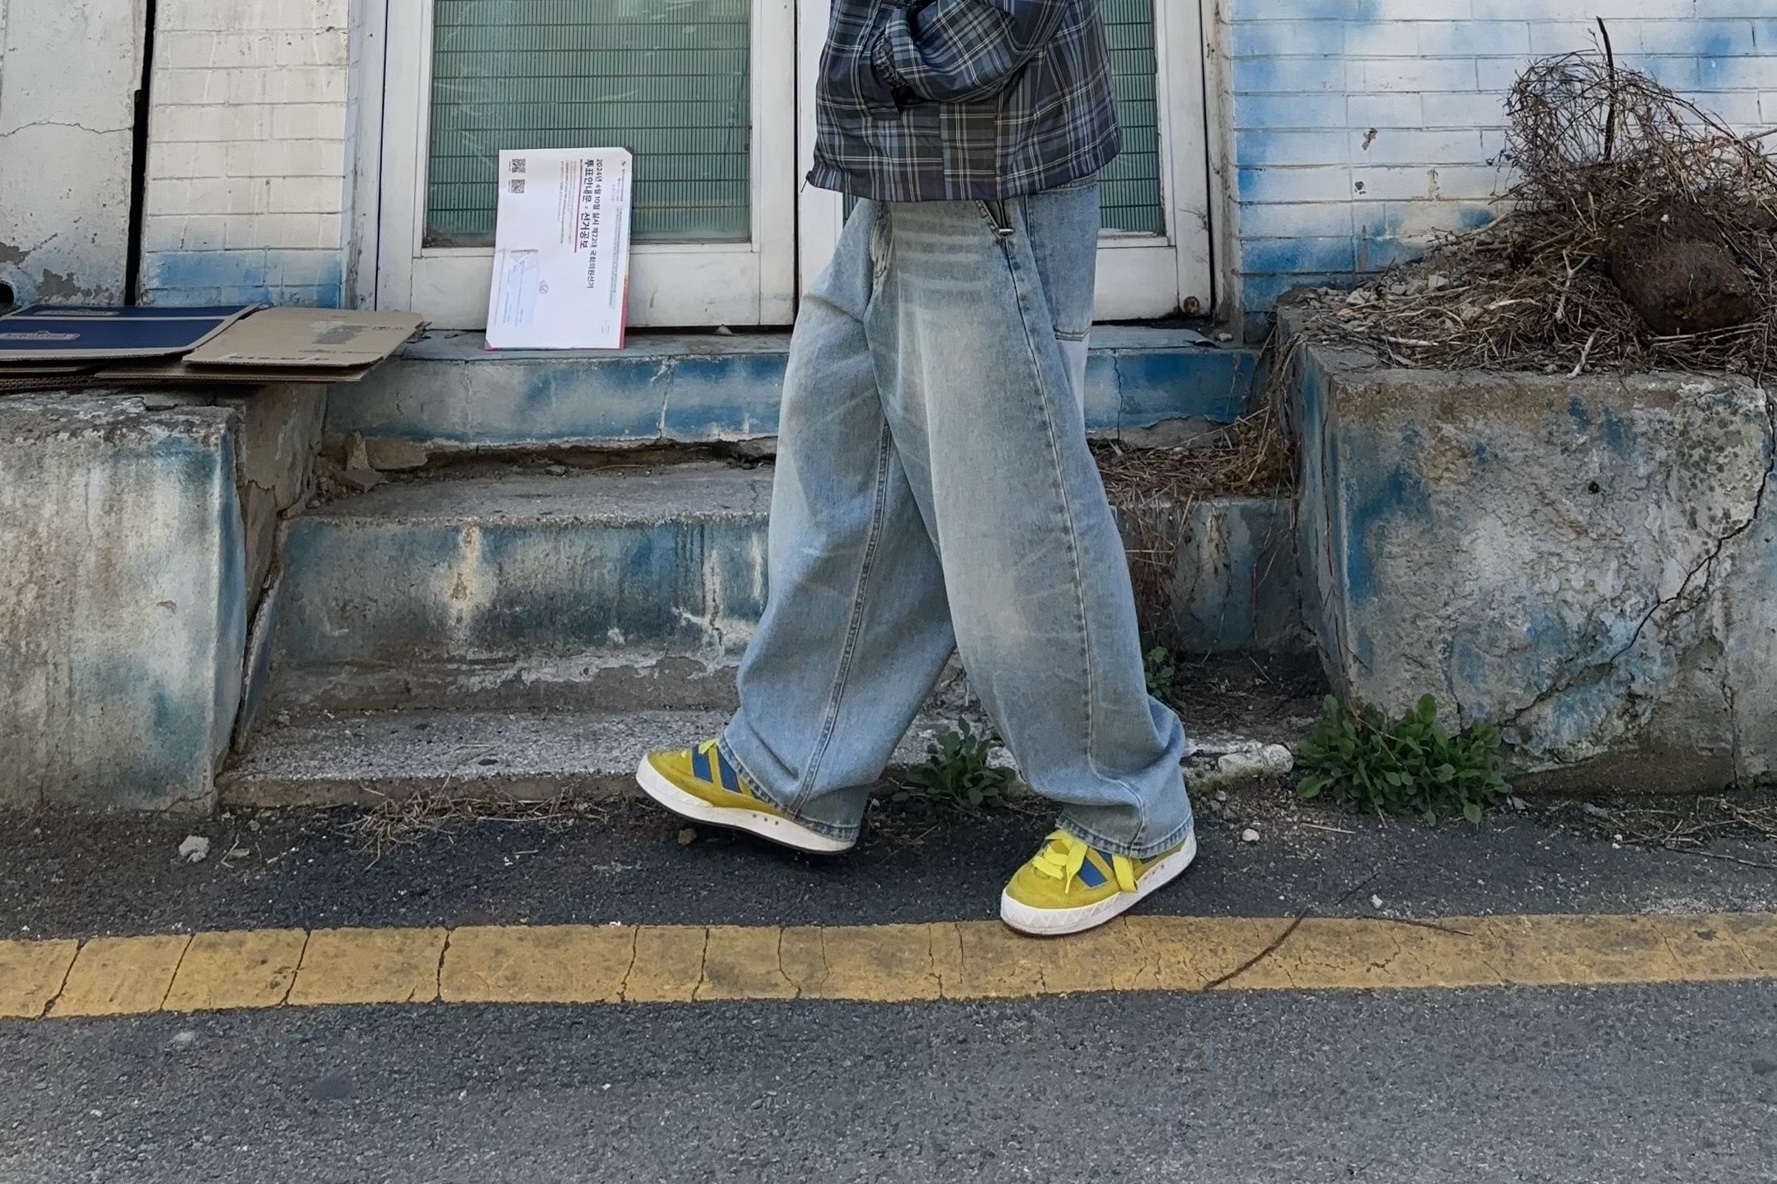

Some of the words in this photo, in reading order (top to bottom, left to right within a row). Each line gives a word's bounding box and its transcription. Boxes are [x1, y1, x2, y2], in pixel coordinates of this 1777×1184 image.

[582, 158, 594, 203] 투표안내문
[594, 158, 603, 182] 2024년
[579, 212, 591, 249] 선거공보
